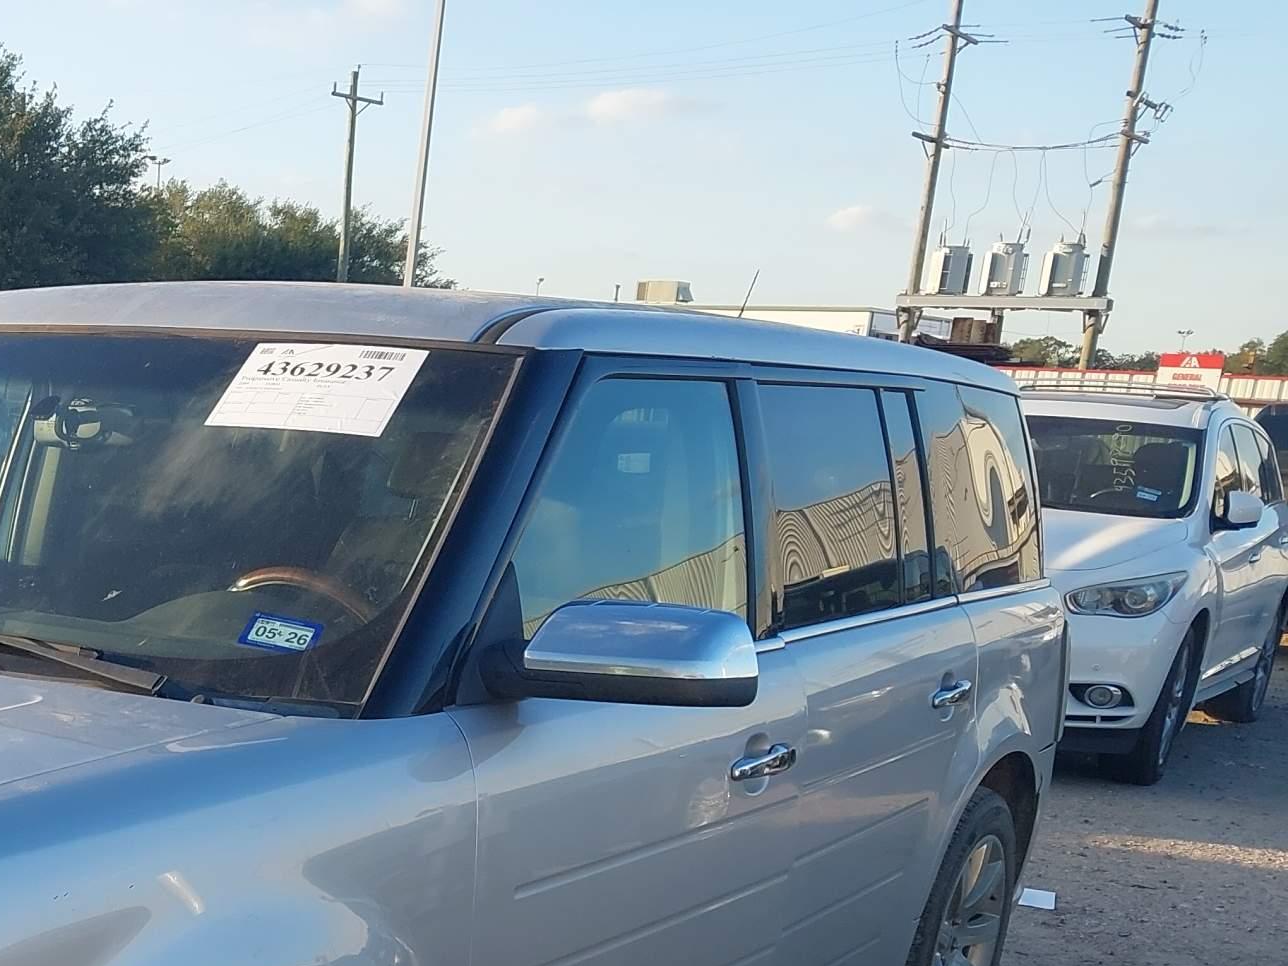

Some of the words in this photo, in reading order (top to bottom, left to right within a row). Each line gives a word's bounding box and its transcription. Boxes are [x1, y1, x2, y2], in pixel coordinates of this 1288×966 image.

[257, 360, 395, 382] 43629237
[255, 625, 279, 639] 05
[284, 632, 310, 646] 26
